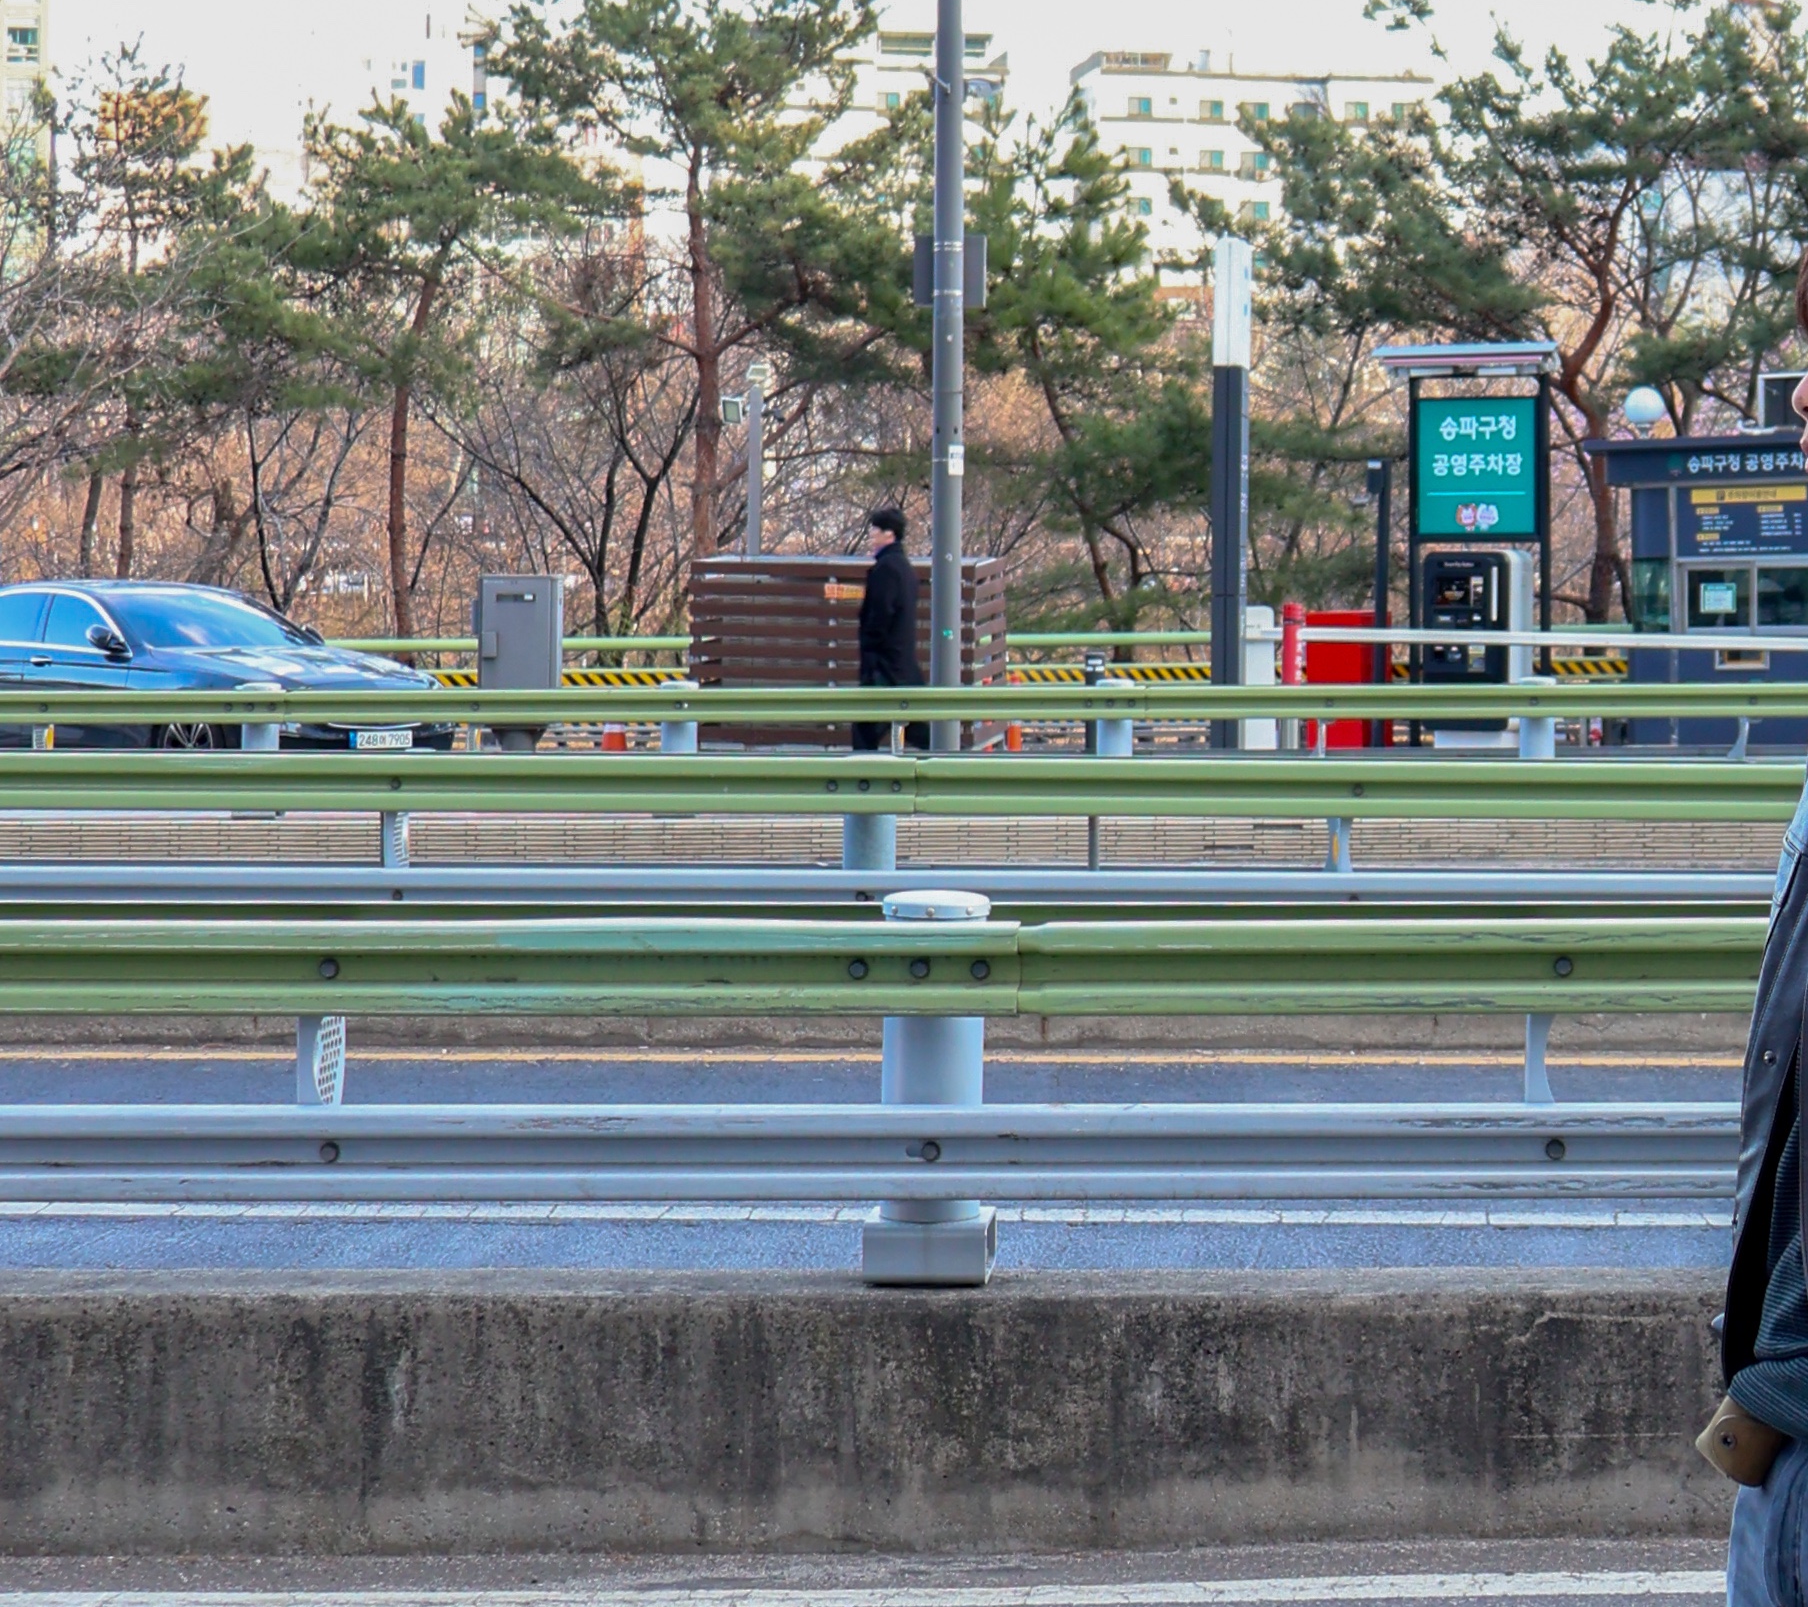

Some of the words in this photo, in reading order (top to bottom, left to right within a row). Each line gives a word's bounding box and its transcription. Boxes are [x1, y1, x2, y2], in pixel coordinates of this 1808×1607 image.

[1439, 415, 1518, 441] 송파구청
[1432, 452, 1524, 476] 공영주차장
[1687, 453, 1741, 473] 송파구청
[388, 733, 411, 745] 7905
